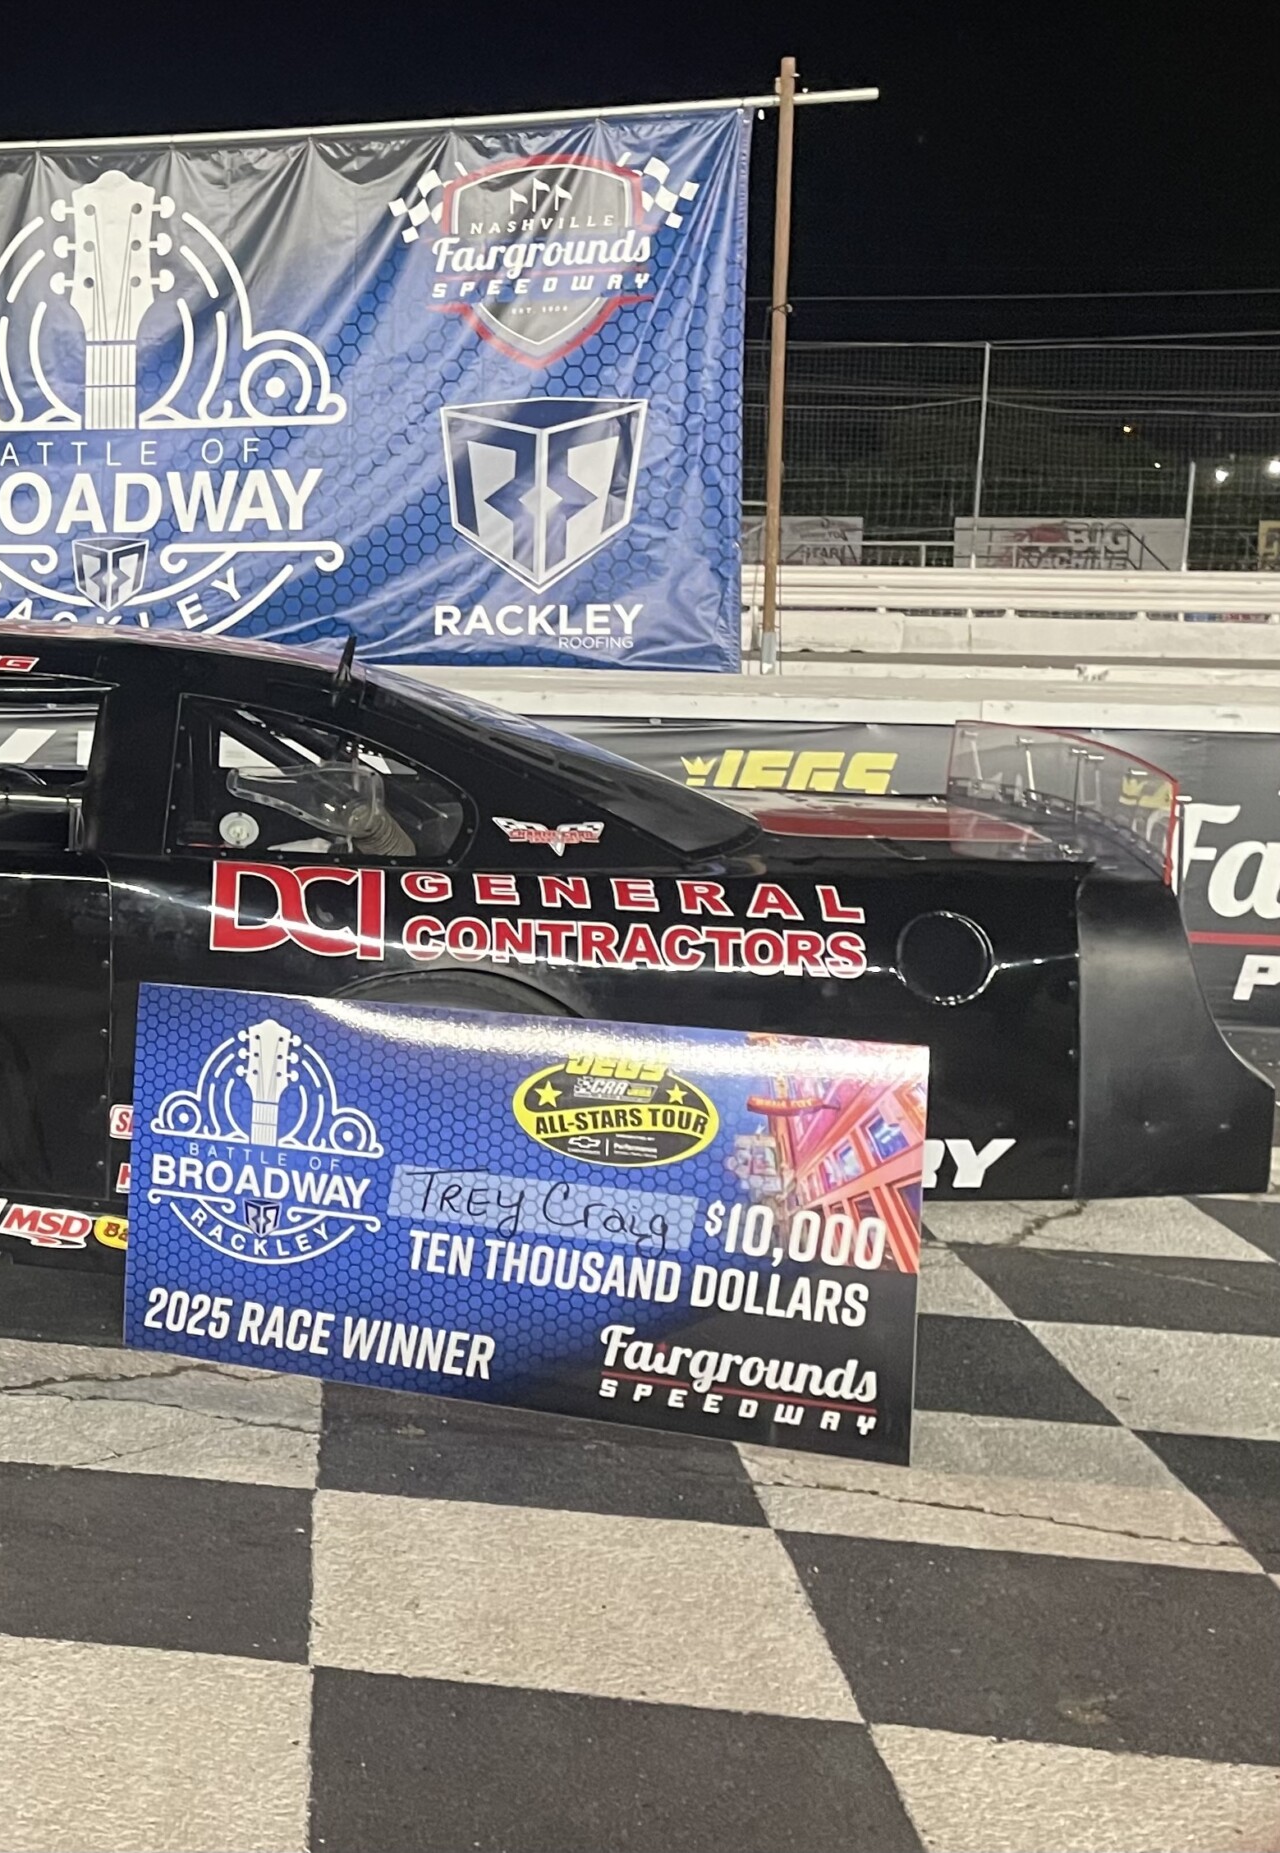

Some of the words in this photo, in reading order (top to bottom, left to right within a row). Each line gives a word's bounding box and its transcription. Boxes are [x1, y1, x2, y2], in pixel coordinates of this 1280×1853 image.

[470, 215, 615, 235] NASHVILLE
[431, 229, 651, 279] Fairgrounds
[432, 273, 651, 298] SPEEDWAY
[201, 438, 260, 464] OF
[434, 604, 644, 636] RACKLEY
[559, 637, 634, 649] ROOFING
[210, 860, 385, 961] DCI
[401, 872, 866, 924] GENERAL
[402, 917, 867, 979] CONTRACTORS
[536, 1108, 643, 1135] ALL-STARS
[648, 1108, 708, 1135] TOUR
[152, 1154, 370, 1210] BROADWAY
[189, 1142, 287, 1167] BATTLE
[309, 1157, 342, 1173] OF
[4, 1208, 90, 1238] MSD
[190, 1209, 329, 1256] RACKLEY
[542, 1181, 669, 1260] Craig
[705, 1200, 887, 1271] $10,000
[408, 1230, 480, 1277] TEN
[485, 1239, 681, 1303] THOUSAND
[691, 1265, 869, 1328] DOLLARS
[143, 1287, 233, 1339] 2025
[237, 1301, 335, 1355] RACE
[343, 1316, 496, 1380] WINNER
[600, 1325, 877, 1403] Fairgrounds
[599, 1378, 877, 1436] SPEEDWAY
